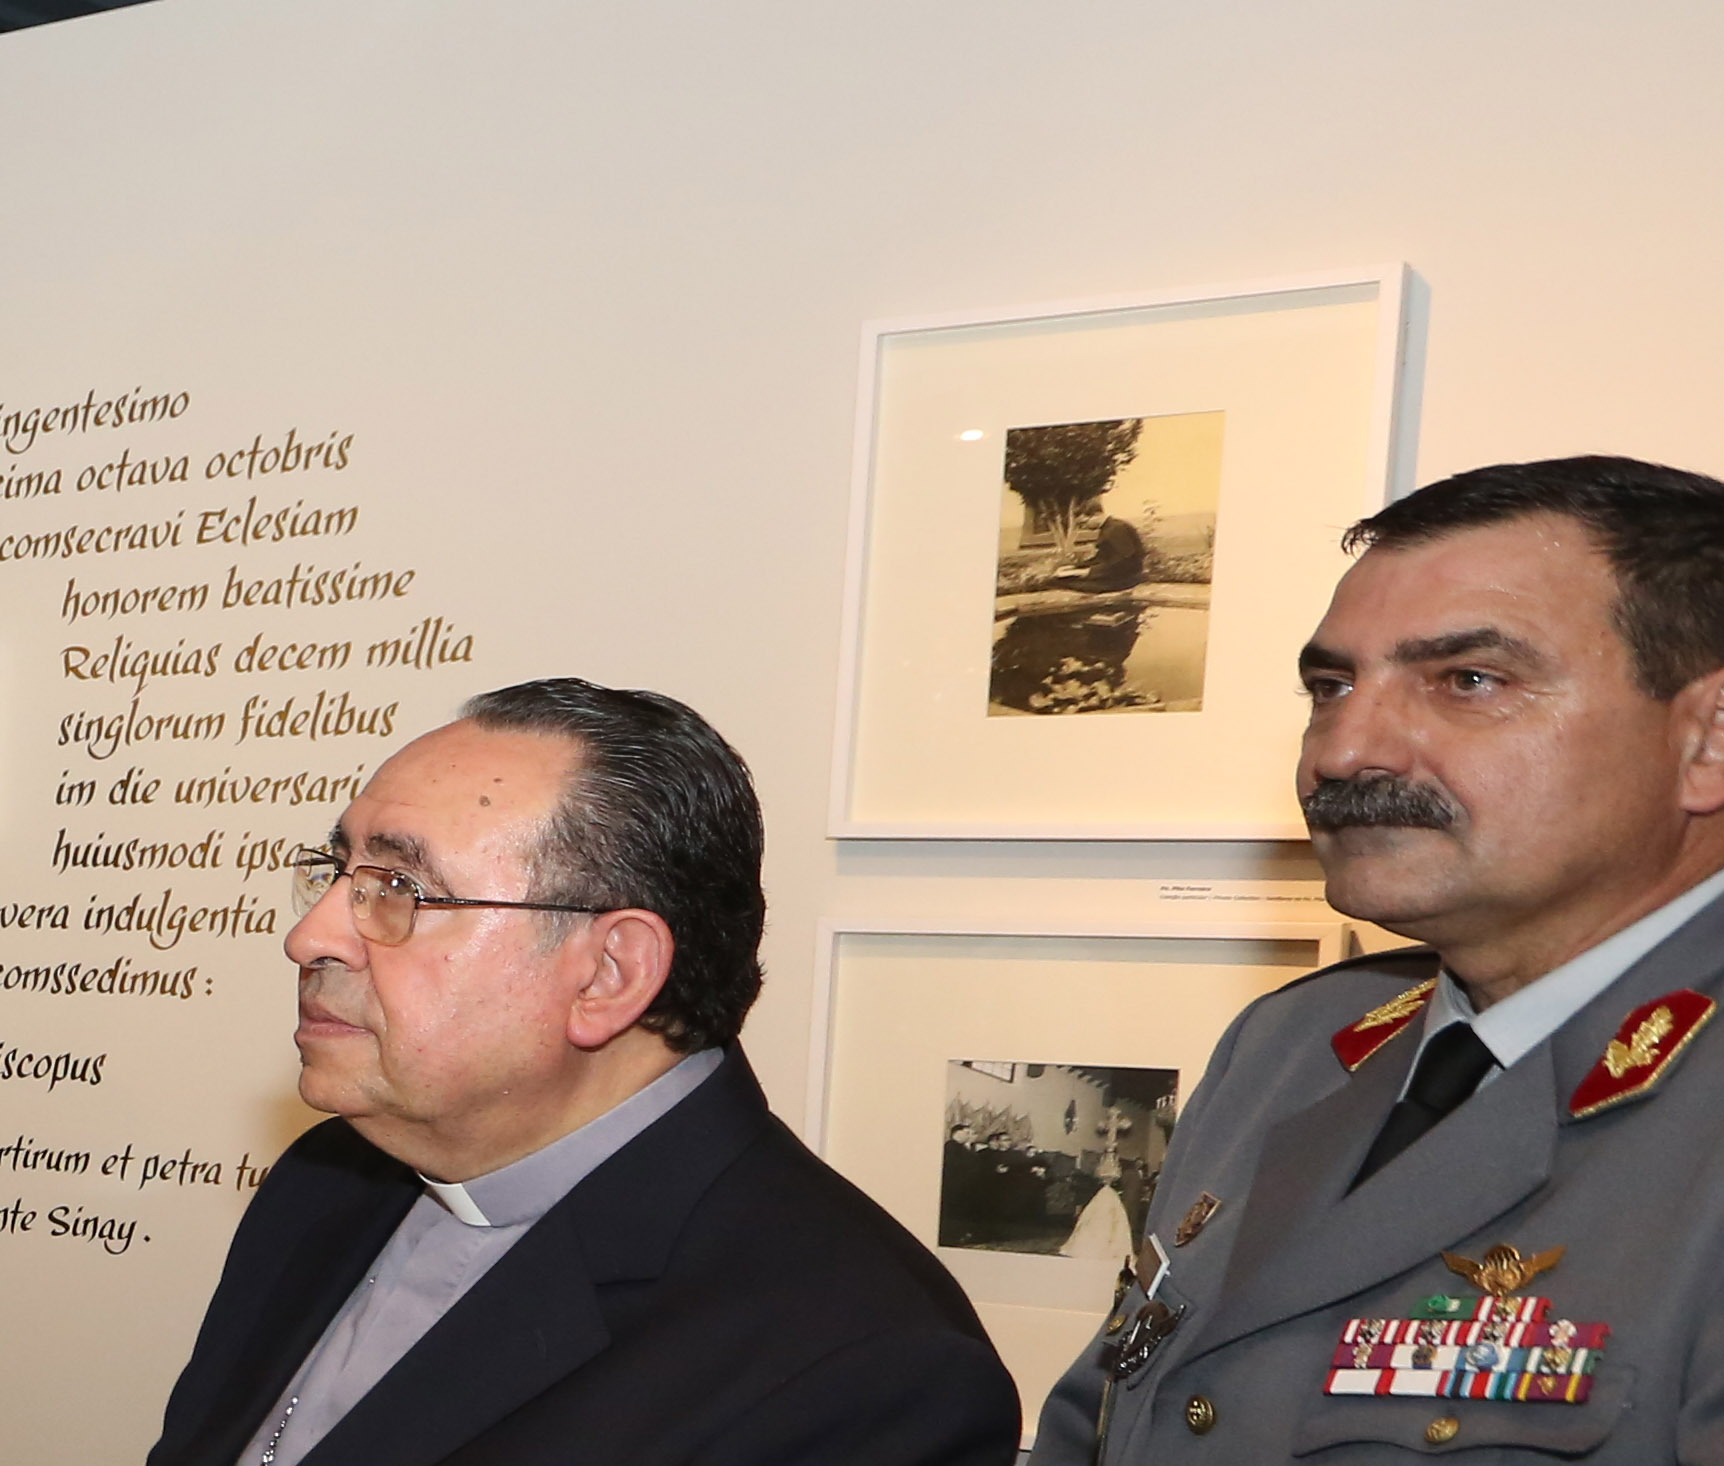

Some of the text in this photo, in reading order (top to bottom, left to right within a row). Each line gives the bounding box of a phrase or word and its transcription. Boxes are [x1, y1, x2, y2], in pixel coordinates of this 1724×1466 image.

[76, 449, 189, 493] octava
[205, 428, 355, 480] octobris
[195, 496, 359, 547] Eclesiam
[60, 561, 417, 625] honorem beatissime
[60, 615, 474, 694] Reliquias decem millia
[57, 690, 399, 760] singlorum fidelibus
[55, 770, 96, 806] im
[108, 765, 161, 806] die
[51, 827, 225, 875] huiusmodi
[0, 902, 69, 930] vera
[83, 888, 277, 950] indulgentia
[101, 1144, 135, 1181] et
[139, 1148, 223, 1191] petra
[47, 1206, 137, 1255] Sinay
